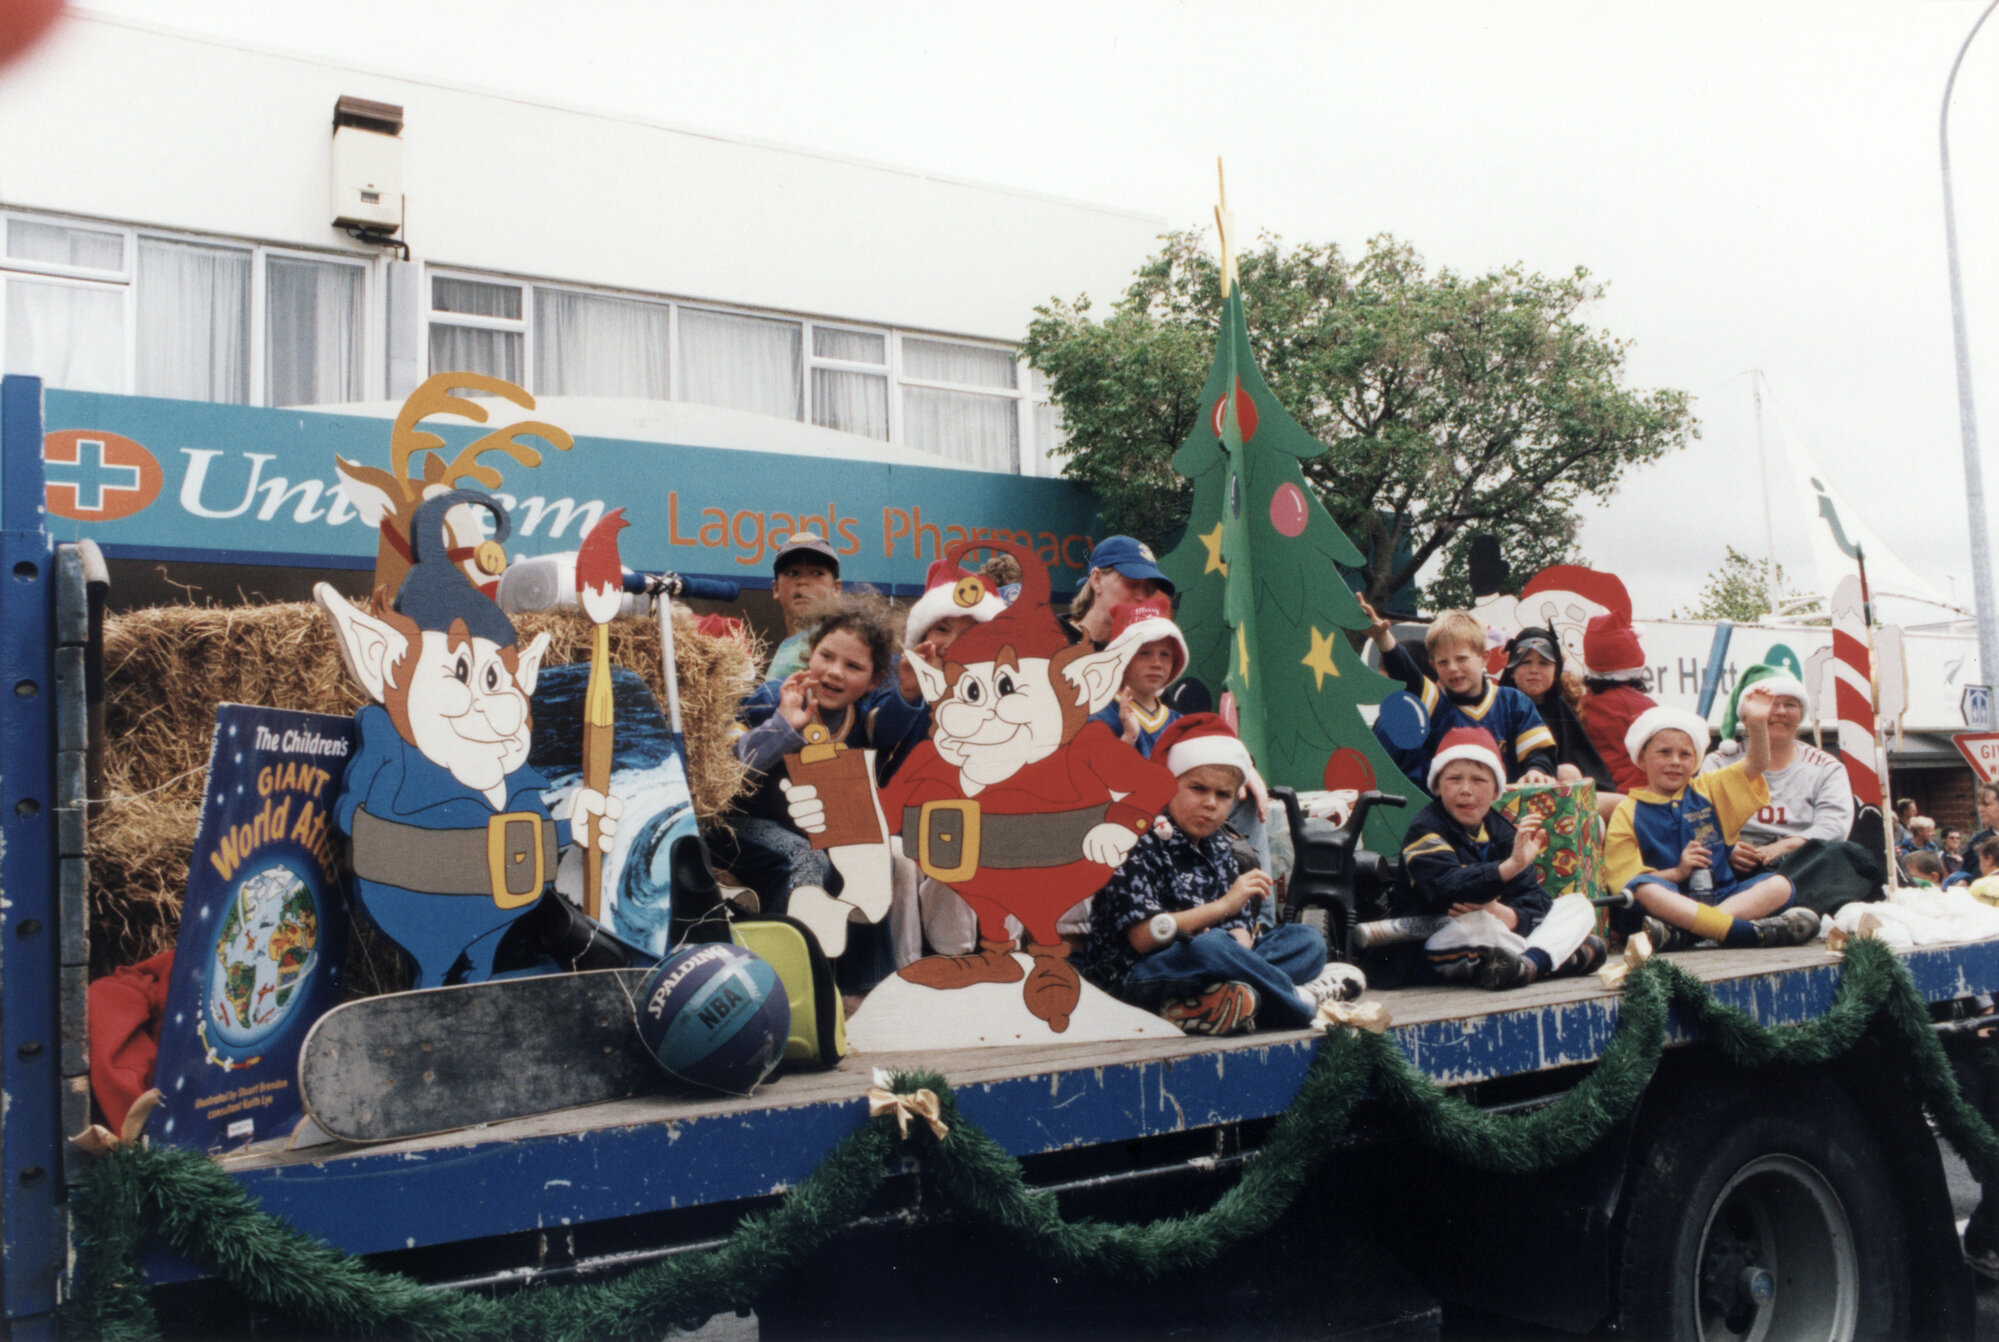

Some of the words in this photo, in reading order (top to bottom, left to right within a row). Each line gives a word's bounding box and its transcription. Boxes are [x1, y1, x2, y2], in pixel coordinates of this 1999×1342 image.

[669, 491, 860, 565] Lagan's
[883, 505, 1095, 570] Pharmac
[1678, 656, 1738, 696] Htt
[255, 725, 281, 752] The
[281, 729, 349, 757] Children's
[257, 761, 331, 798] GIANT
[209, 795, 291, 882] World
[648, 944, 733, 1020] SPALDING
[697, 987, 743, 1031] NBA
